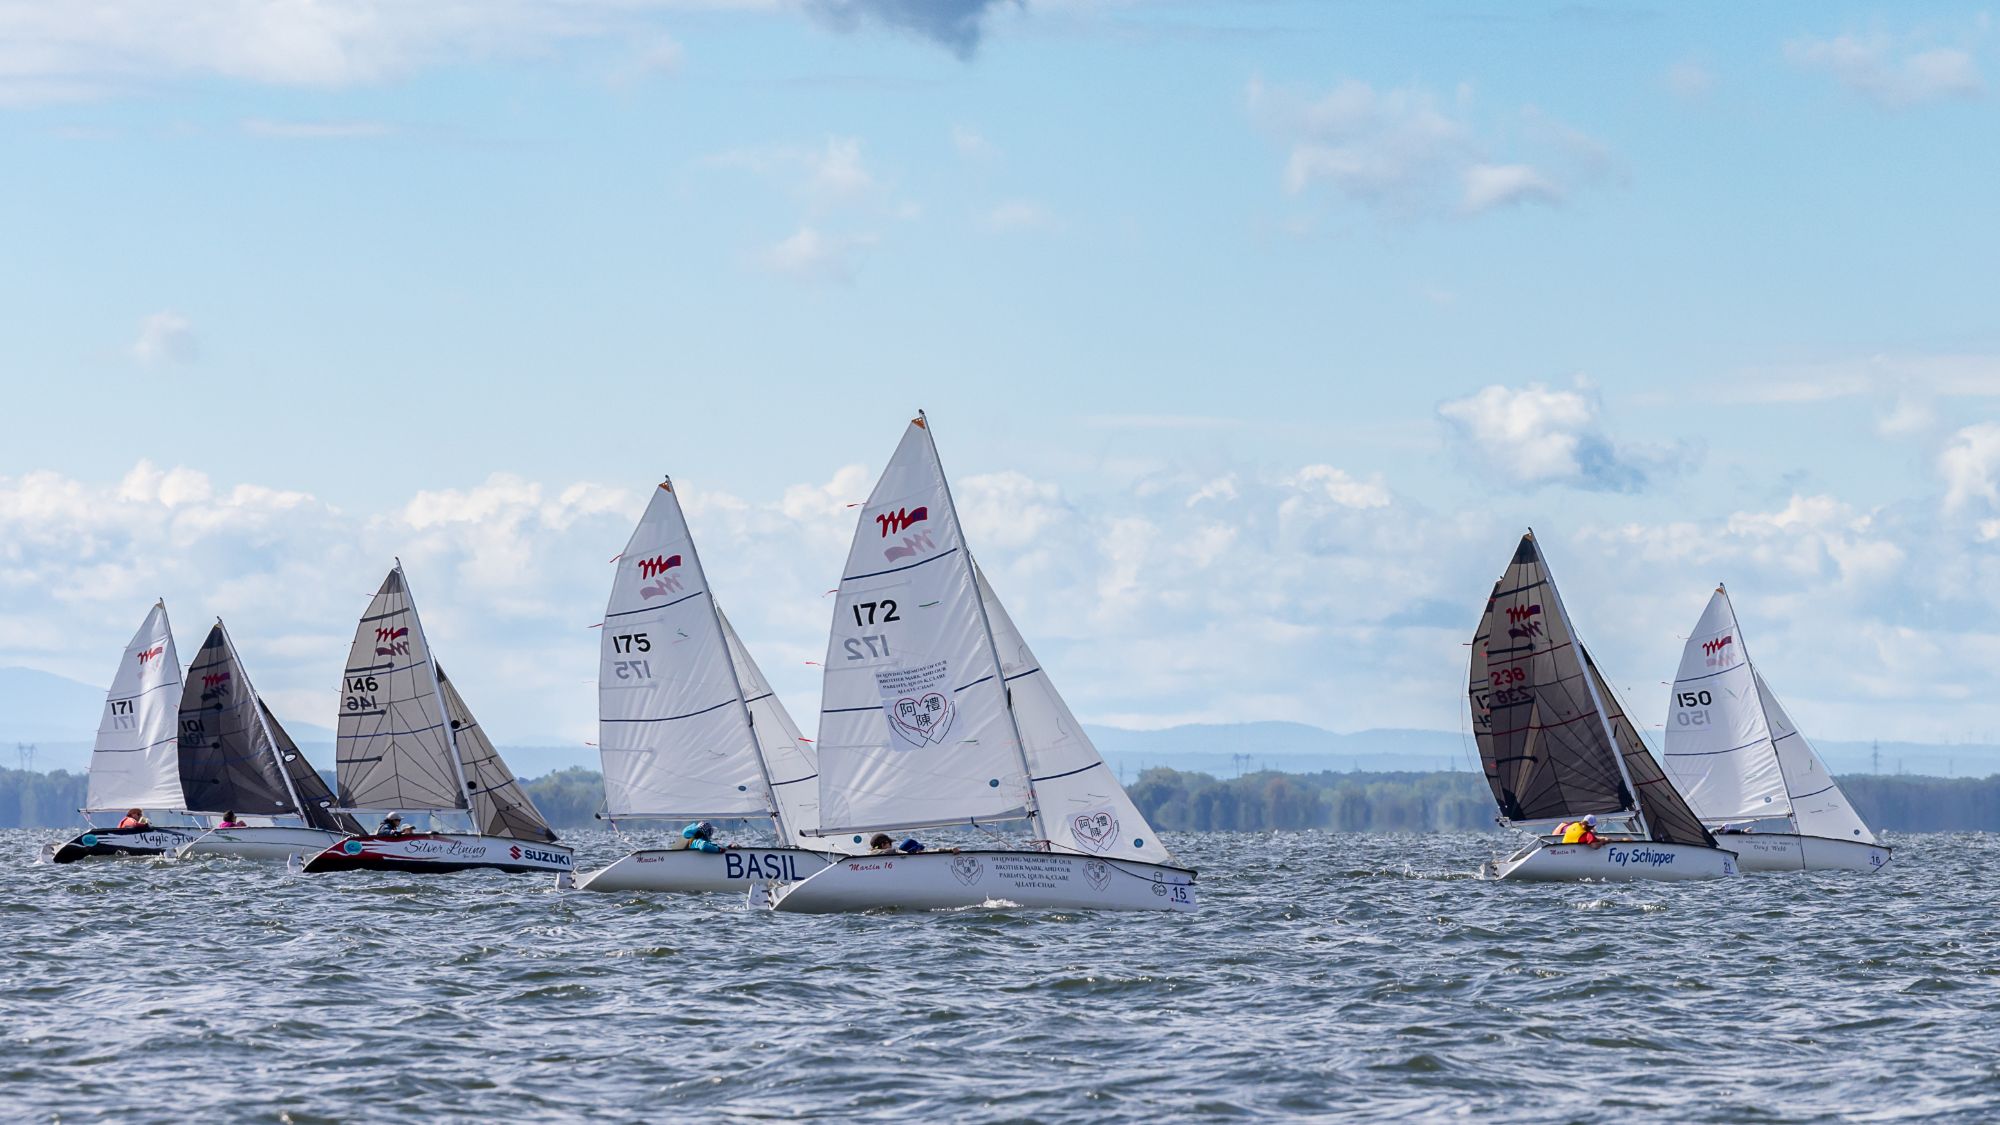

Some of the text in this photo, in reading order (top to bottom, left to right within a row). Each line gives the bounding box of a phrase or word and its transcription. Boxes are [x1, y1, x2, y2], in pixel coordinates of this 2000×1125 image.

[853, 599, 900, 627] 172
[613, 633, 651, 654] 175
[346, 676, 378, 693] 146
[1490, 667, 1525, 686] 238
[1677, 690, 1712, 707] 150
[111, 700, 134, 715] 171
[181, 719, 205, 732] 101
[134, 833, 168, 847] Magic
[404, 840, 487, 858] Silver Lining
[525, 849, 570, 865] SUZUKI
[1608, 847, 1675, 867] Fay Schipper
[725, 853, 805, 880] BASIL
[848, 861, 893, 871] Martin 16
[1172, 886, 1186, 900] 15
